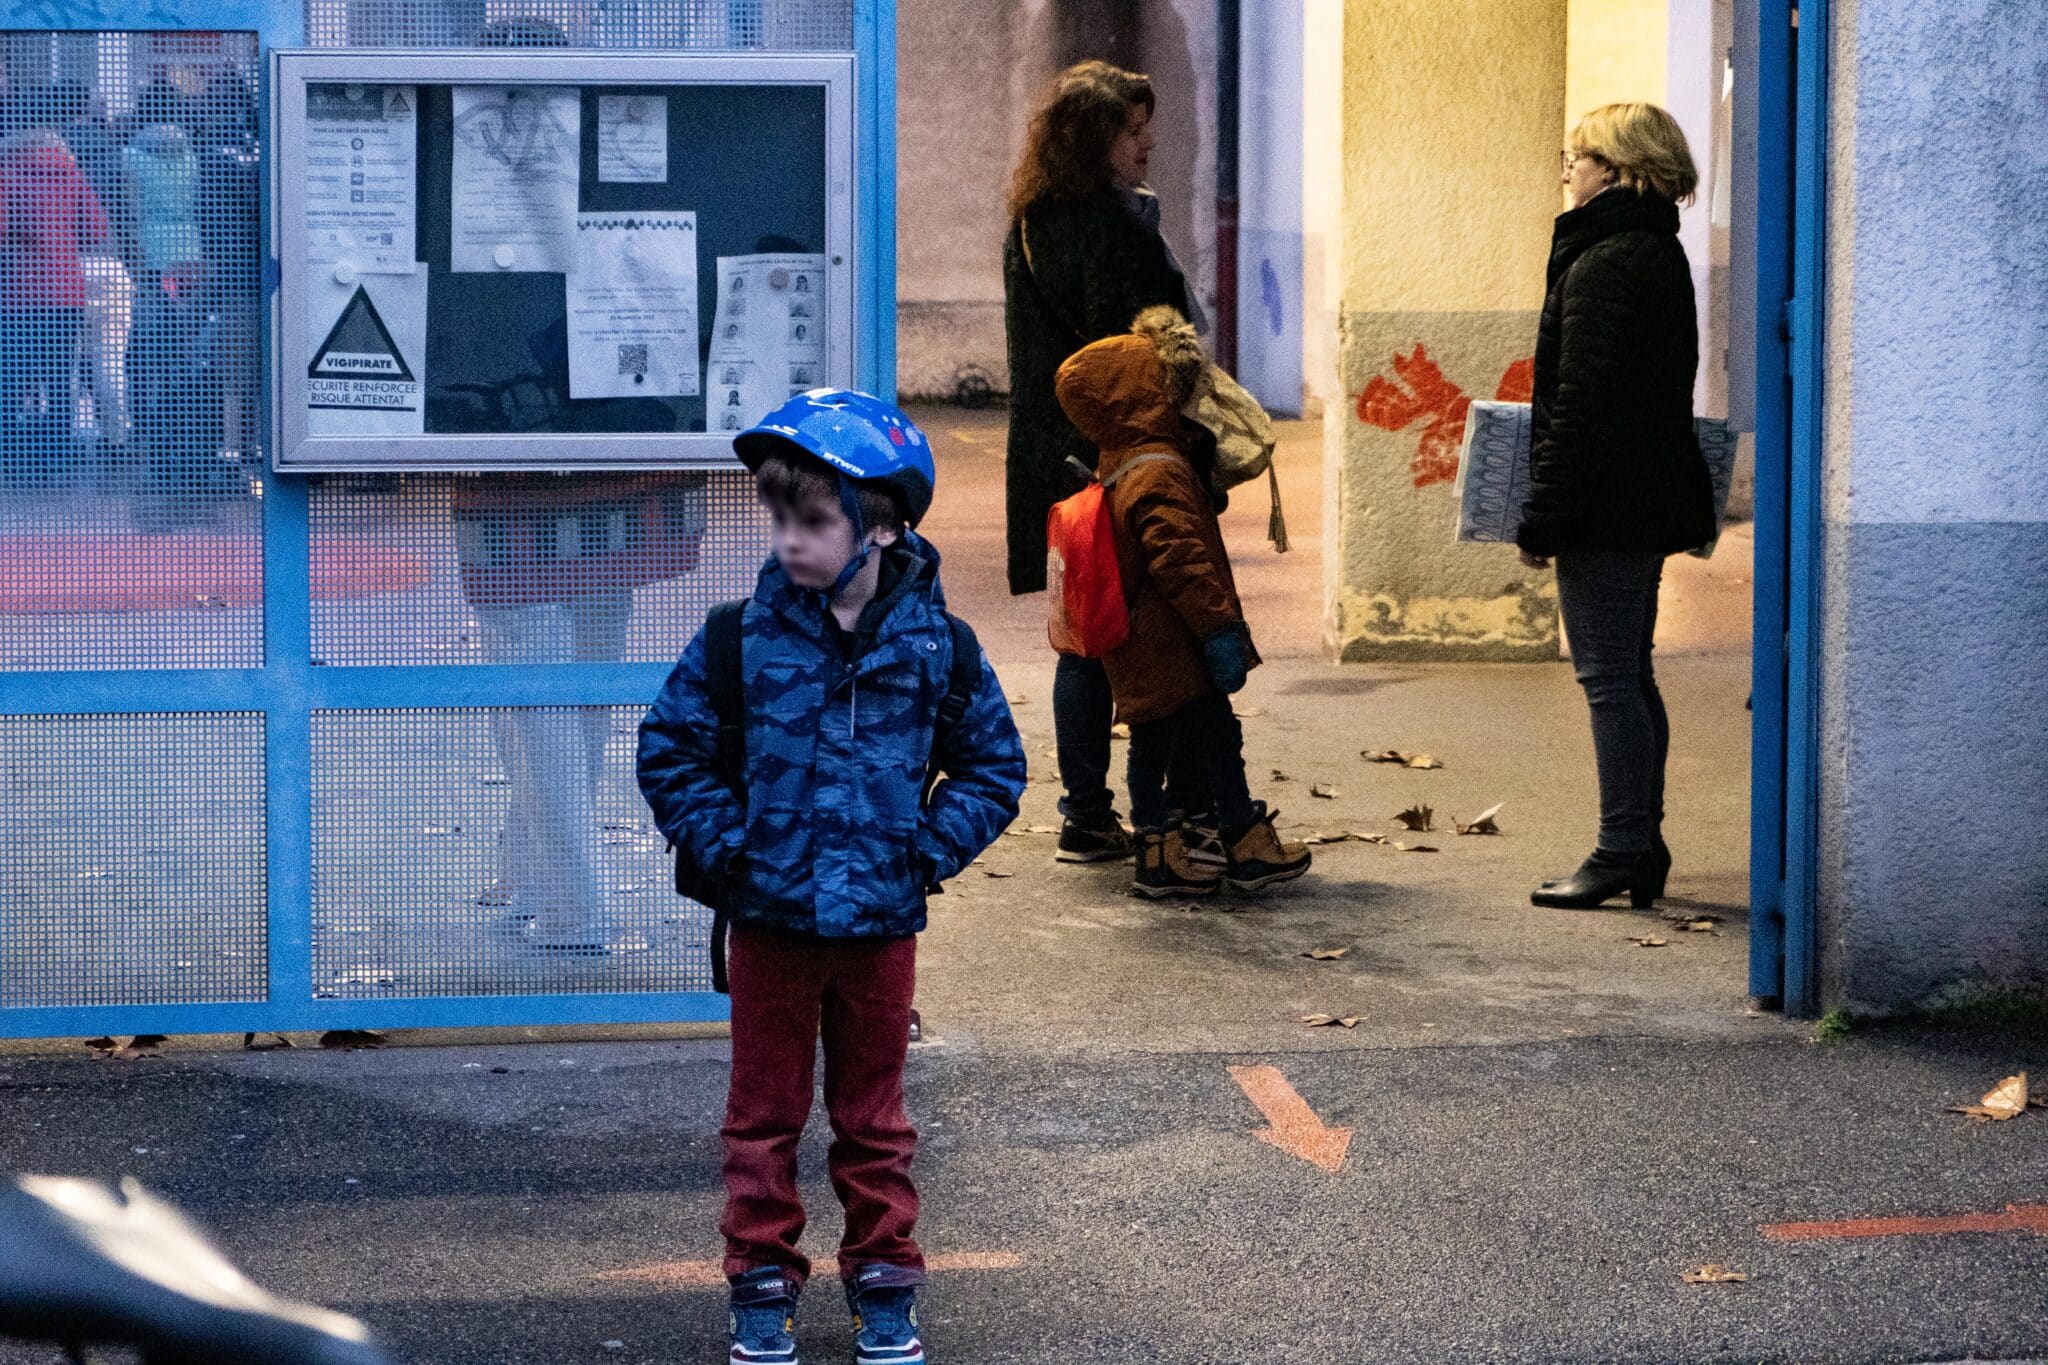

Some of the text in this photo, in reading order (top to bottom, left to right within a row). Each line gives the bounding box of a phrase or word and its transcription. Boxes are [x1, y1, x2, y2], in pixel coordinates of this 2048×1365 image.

[326, 358, 393, 369] VIGIPIRATE
[307, 380, 350, 391] ECURITE
[311, 392, 405, 405] RISQUE ATTENTAT
